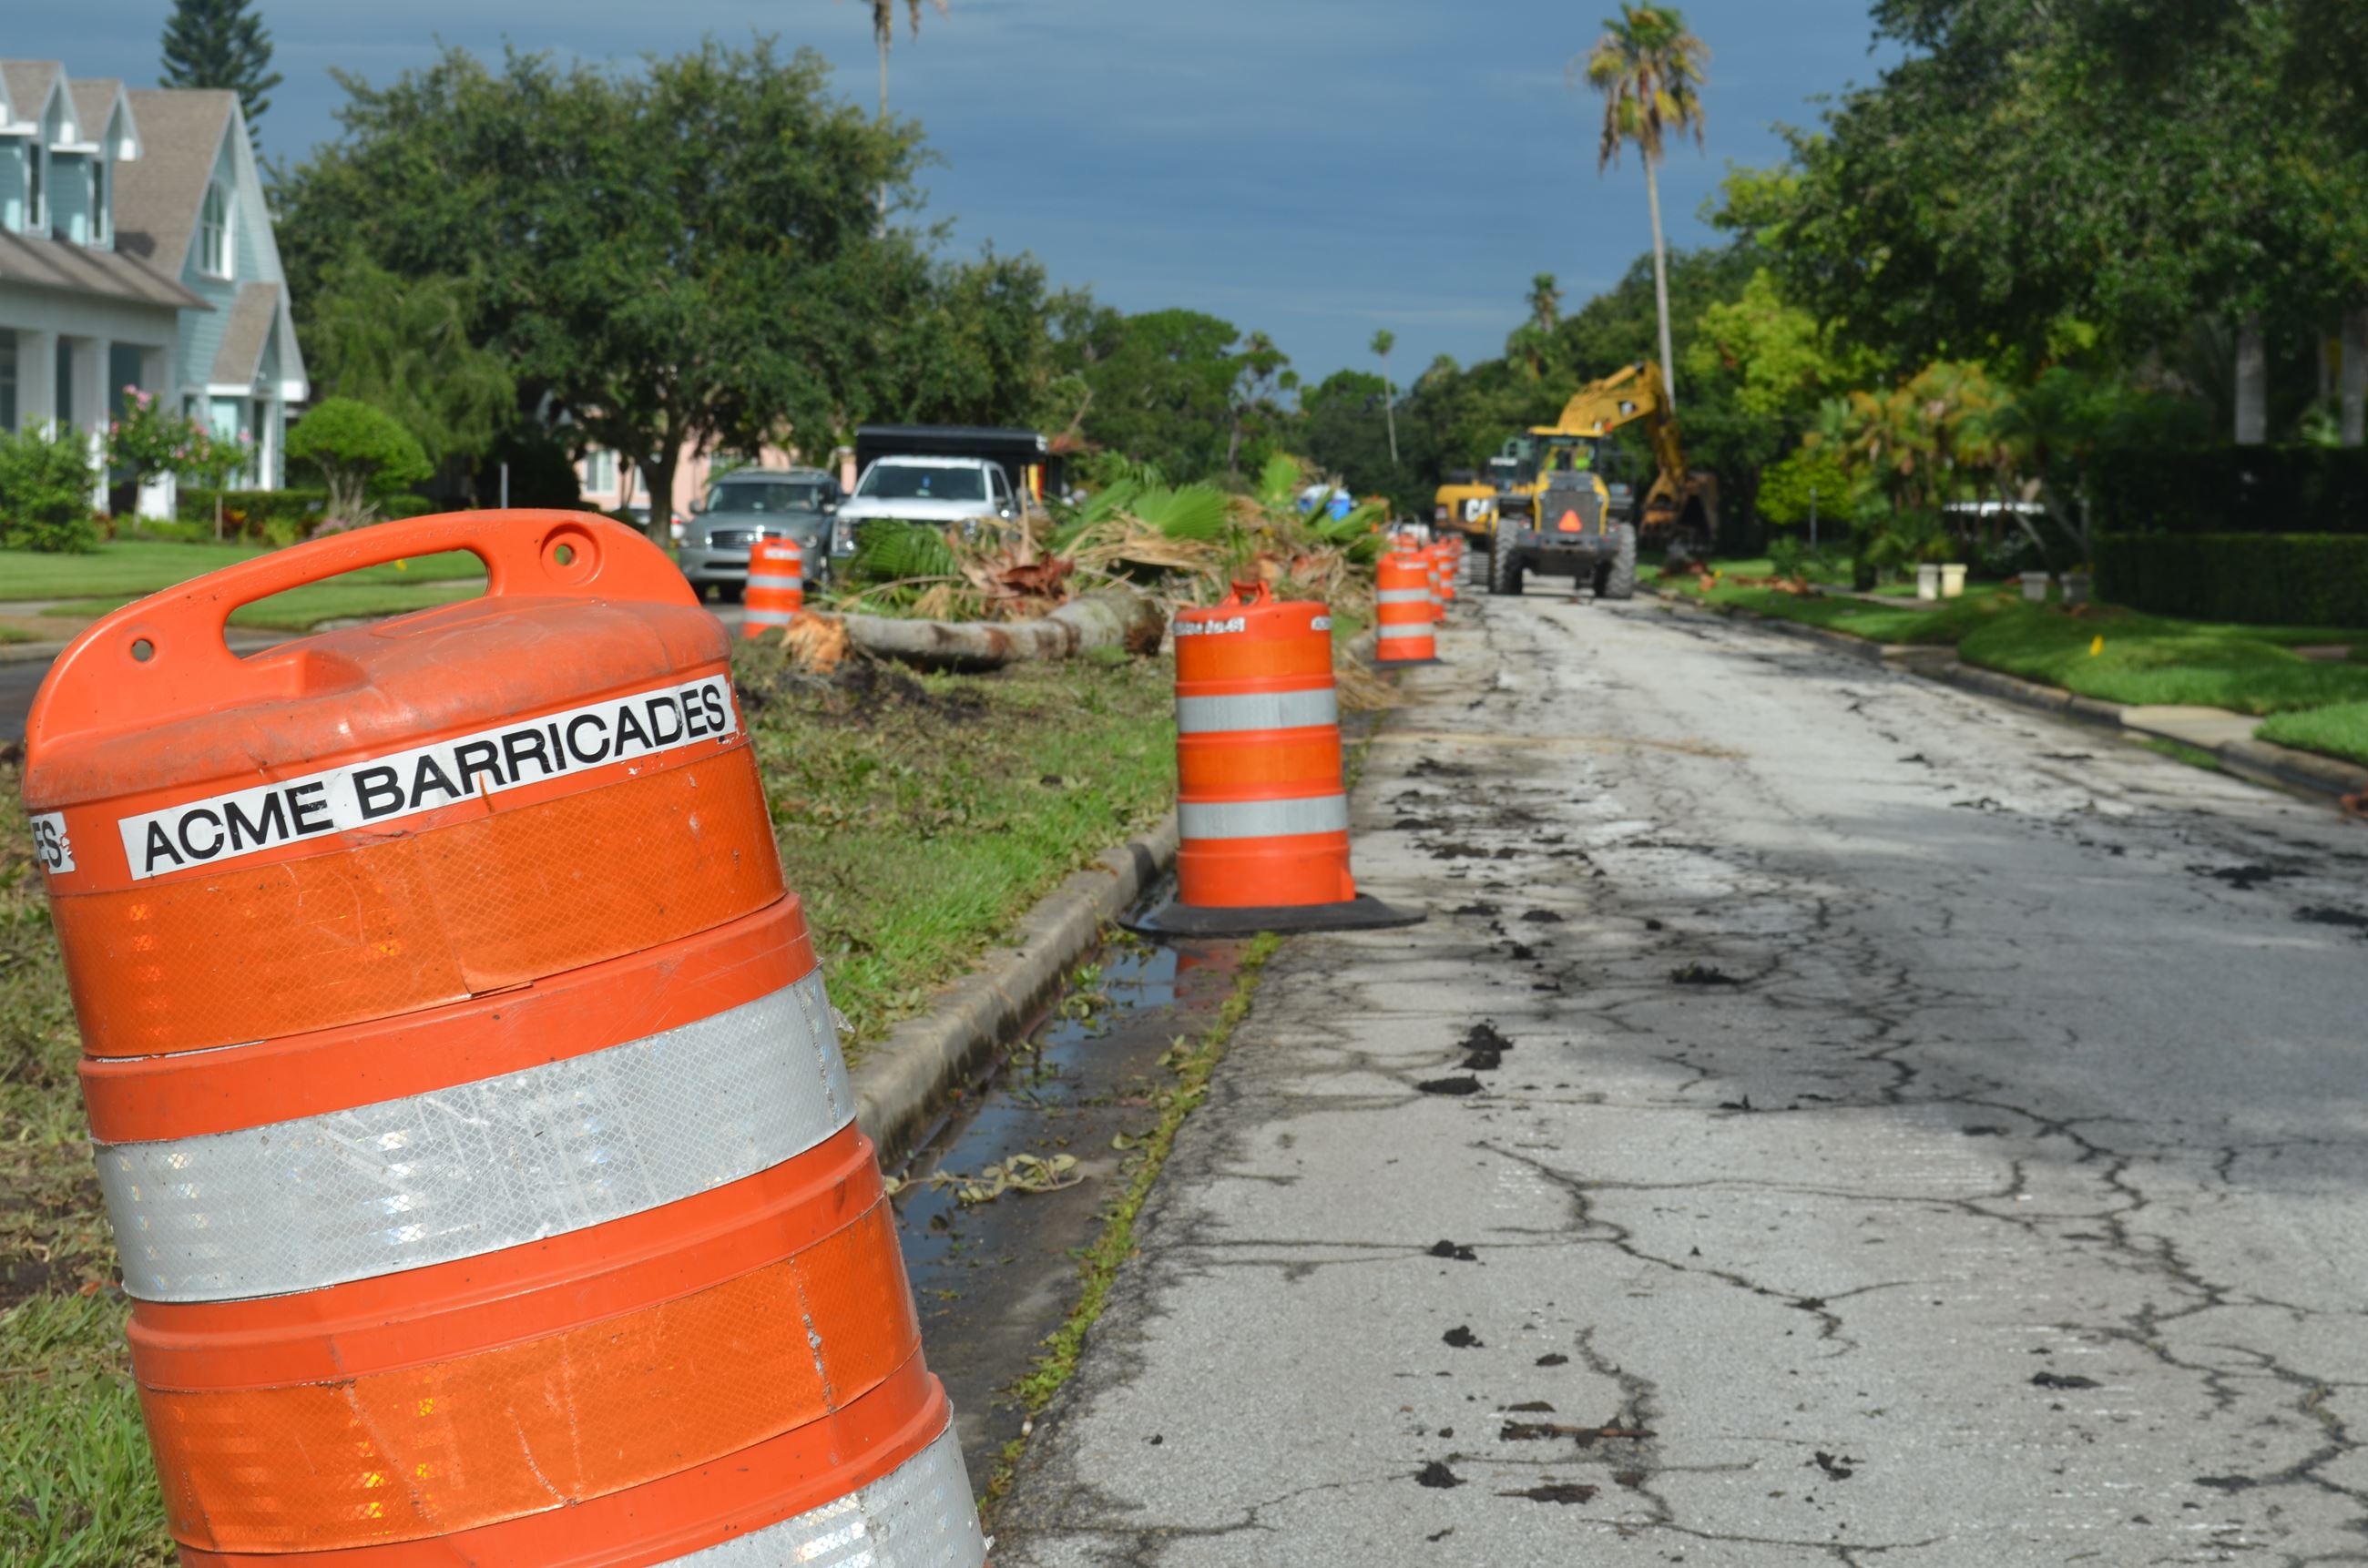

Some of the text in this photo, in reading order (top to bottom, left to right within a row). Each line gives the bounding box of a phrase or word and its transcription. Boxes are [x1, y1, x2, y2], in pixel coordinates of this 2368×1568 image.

[1465, 498, 1490, 523] CA
[146, 684, 726, 872] ACME BARRICADES
